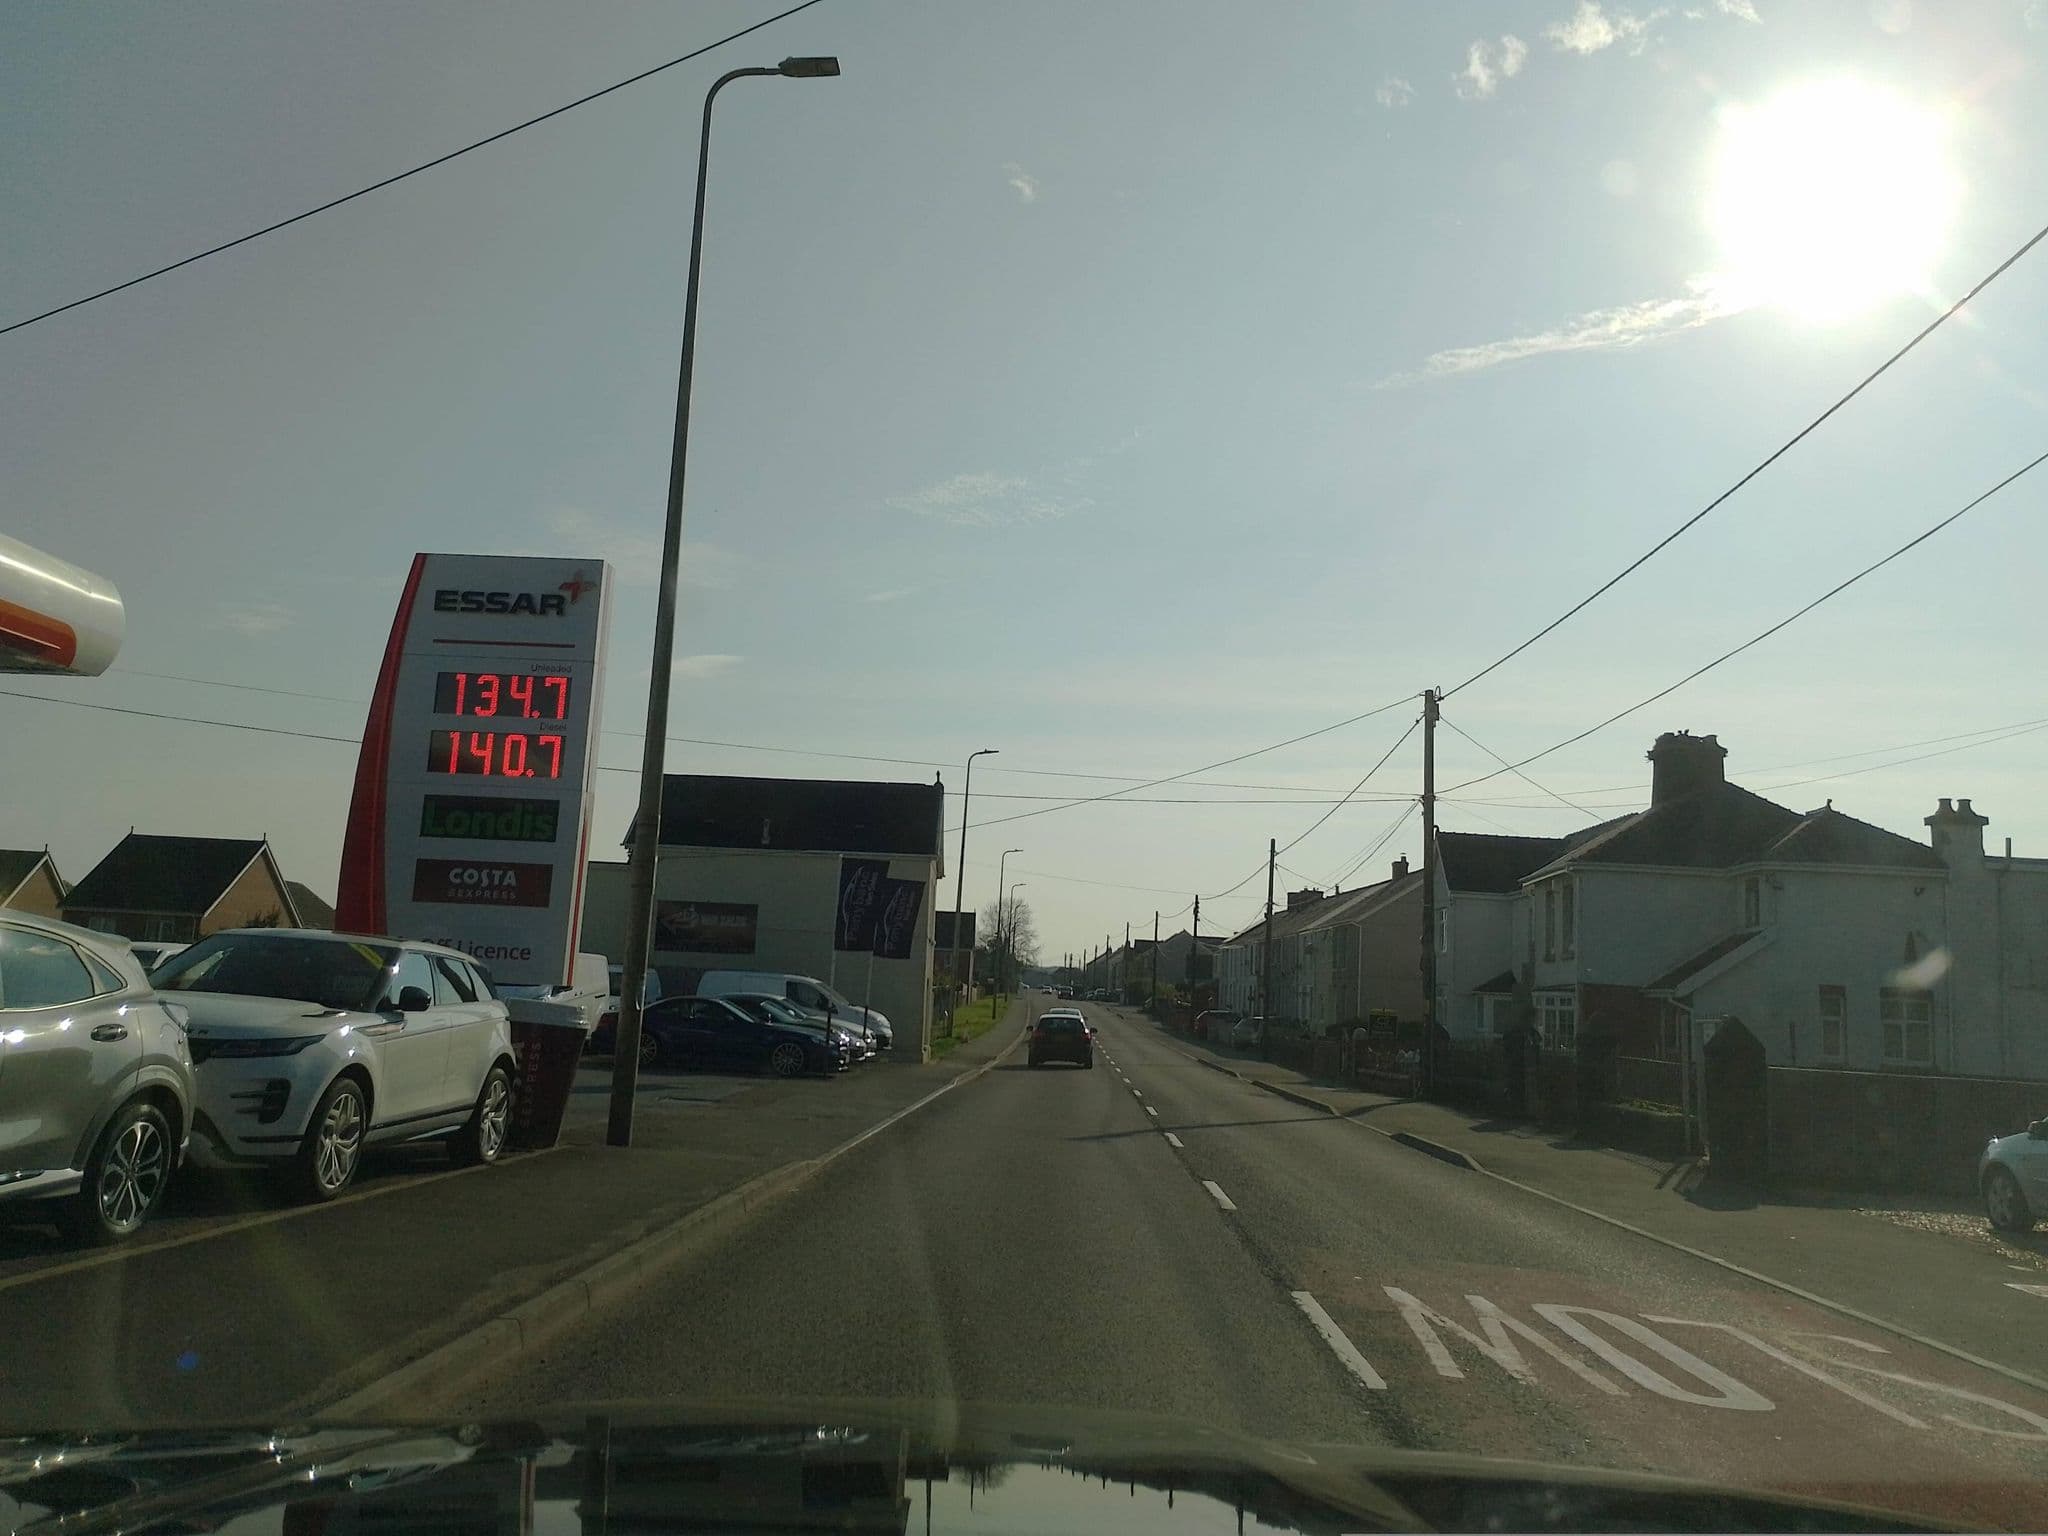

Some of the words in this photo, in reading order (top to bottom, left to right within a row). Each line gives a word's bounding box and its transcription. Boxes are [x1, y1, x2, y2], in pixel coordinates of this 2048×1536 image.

[434, 589, 566, 616] ESSAR
[531, 663, 573, 673] Unleaded
[455, 672, 569, 720] 134.7
[539, 722, 567, 731] Diesel
[448, 730, 563, 780] 140.7
[422, 798, 555, 841] Londis
[448, 867, 517, 888] COSTA
[456, 888, 518, 899] EXPRESS
